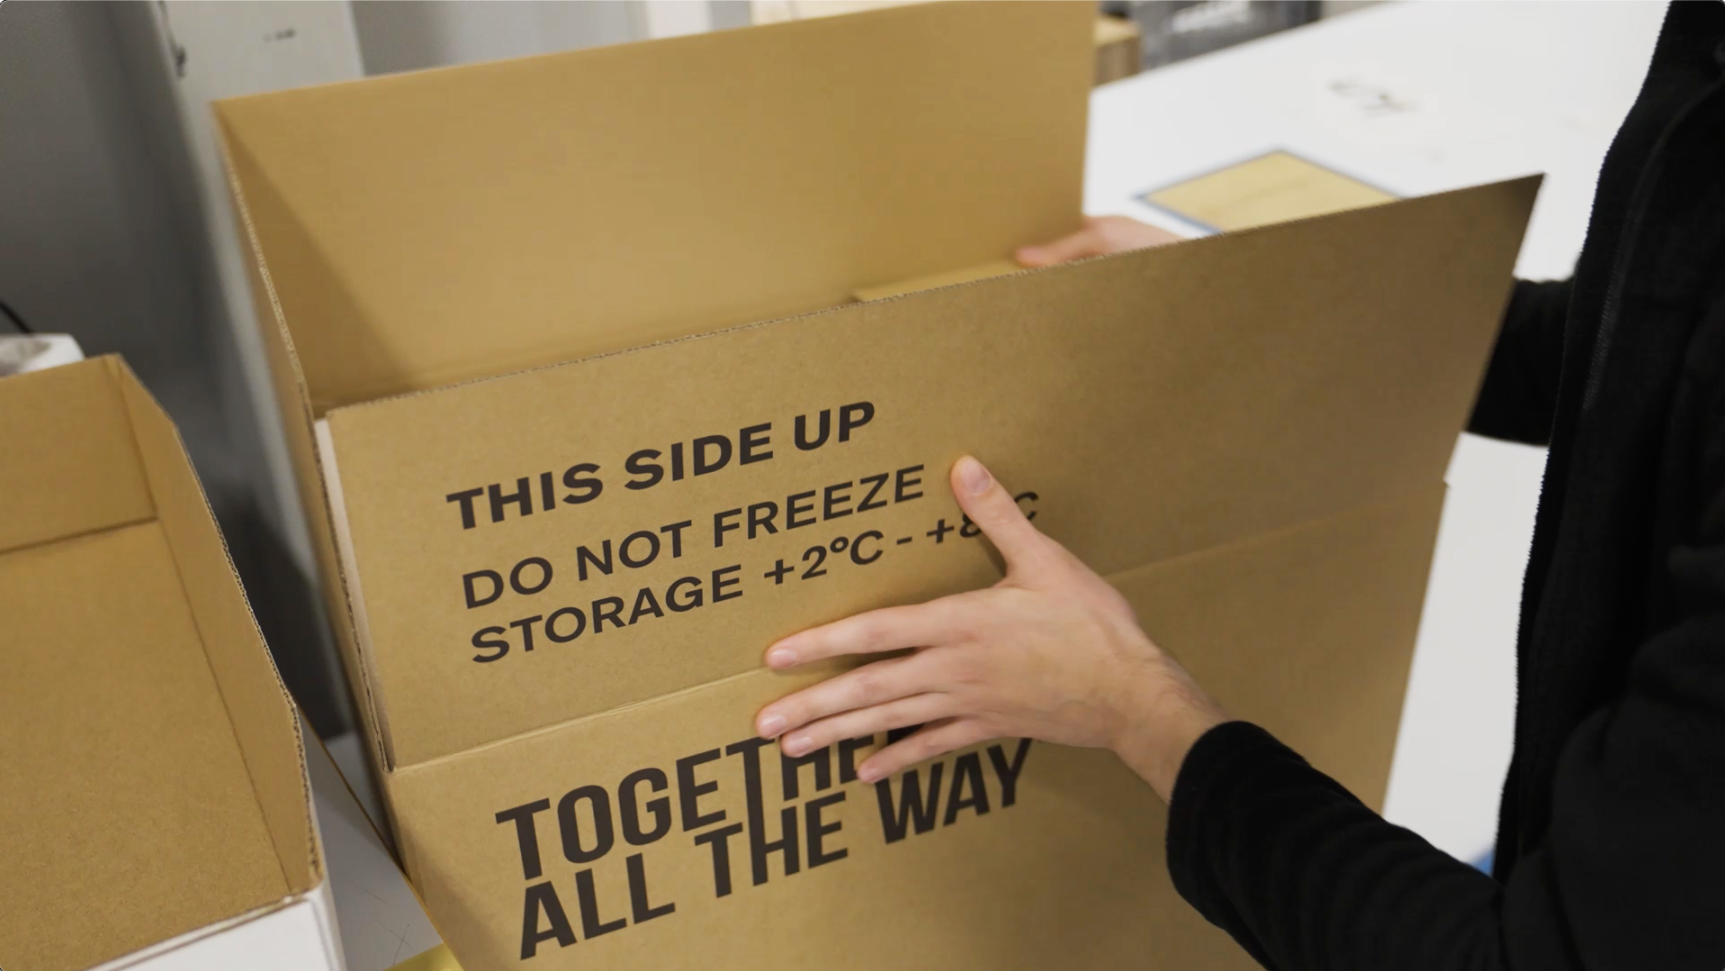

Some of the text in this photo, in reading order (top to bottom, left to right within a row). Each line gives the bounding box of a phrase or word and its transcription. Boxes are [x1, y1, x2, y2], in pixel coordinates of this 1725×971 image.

[446, 401, 875, 530] THIS SIDE UP
[462, 465, 925, 610] DO NOT FREEZE
[471, 564, 743, 663] STORAGE
[763, 530, 884, 585] +2°C
[495, 723, 925, 881] TOGETHE
[520, 738, 1032, 961] ALL THE WAY
